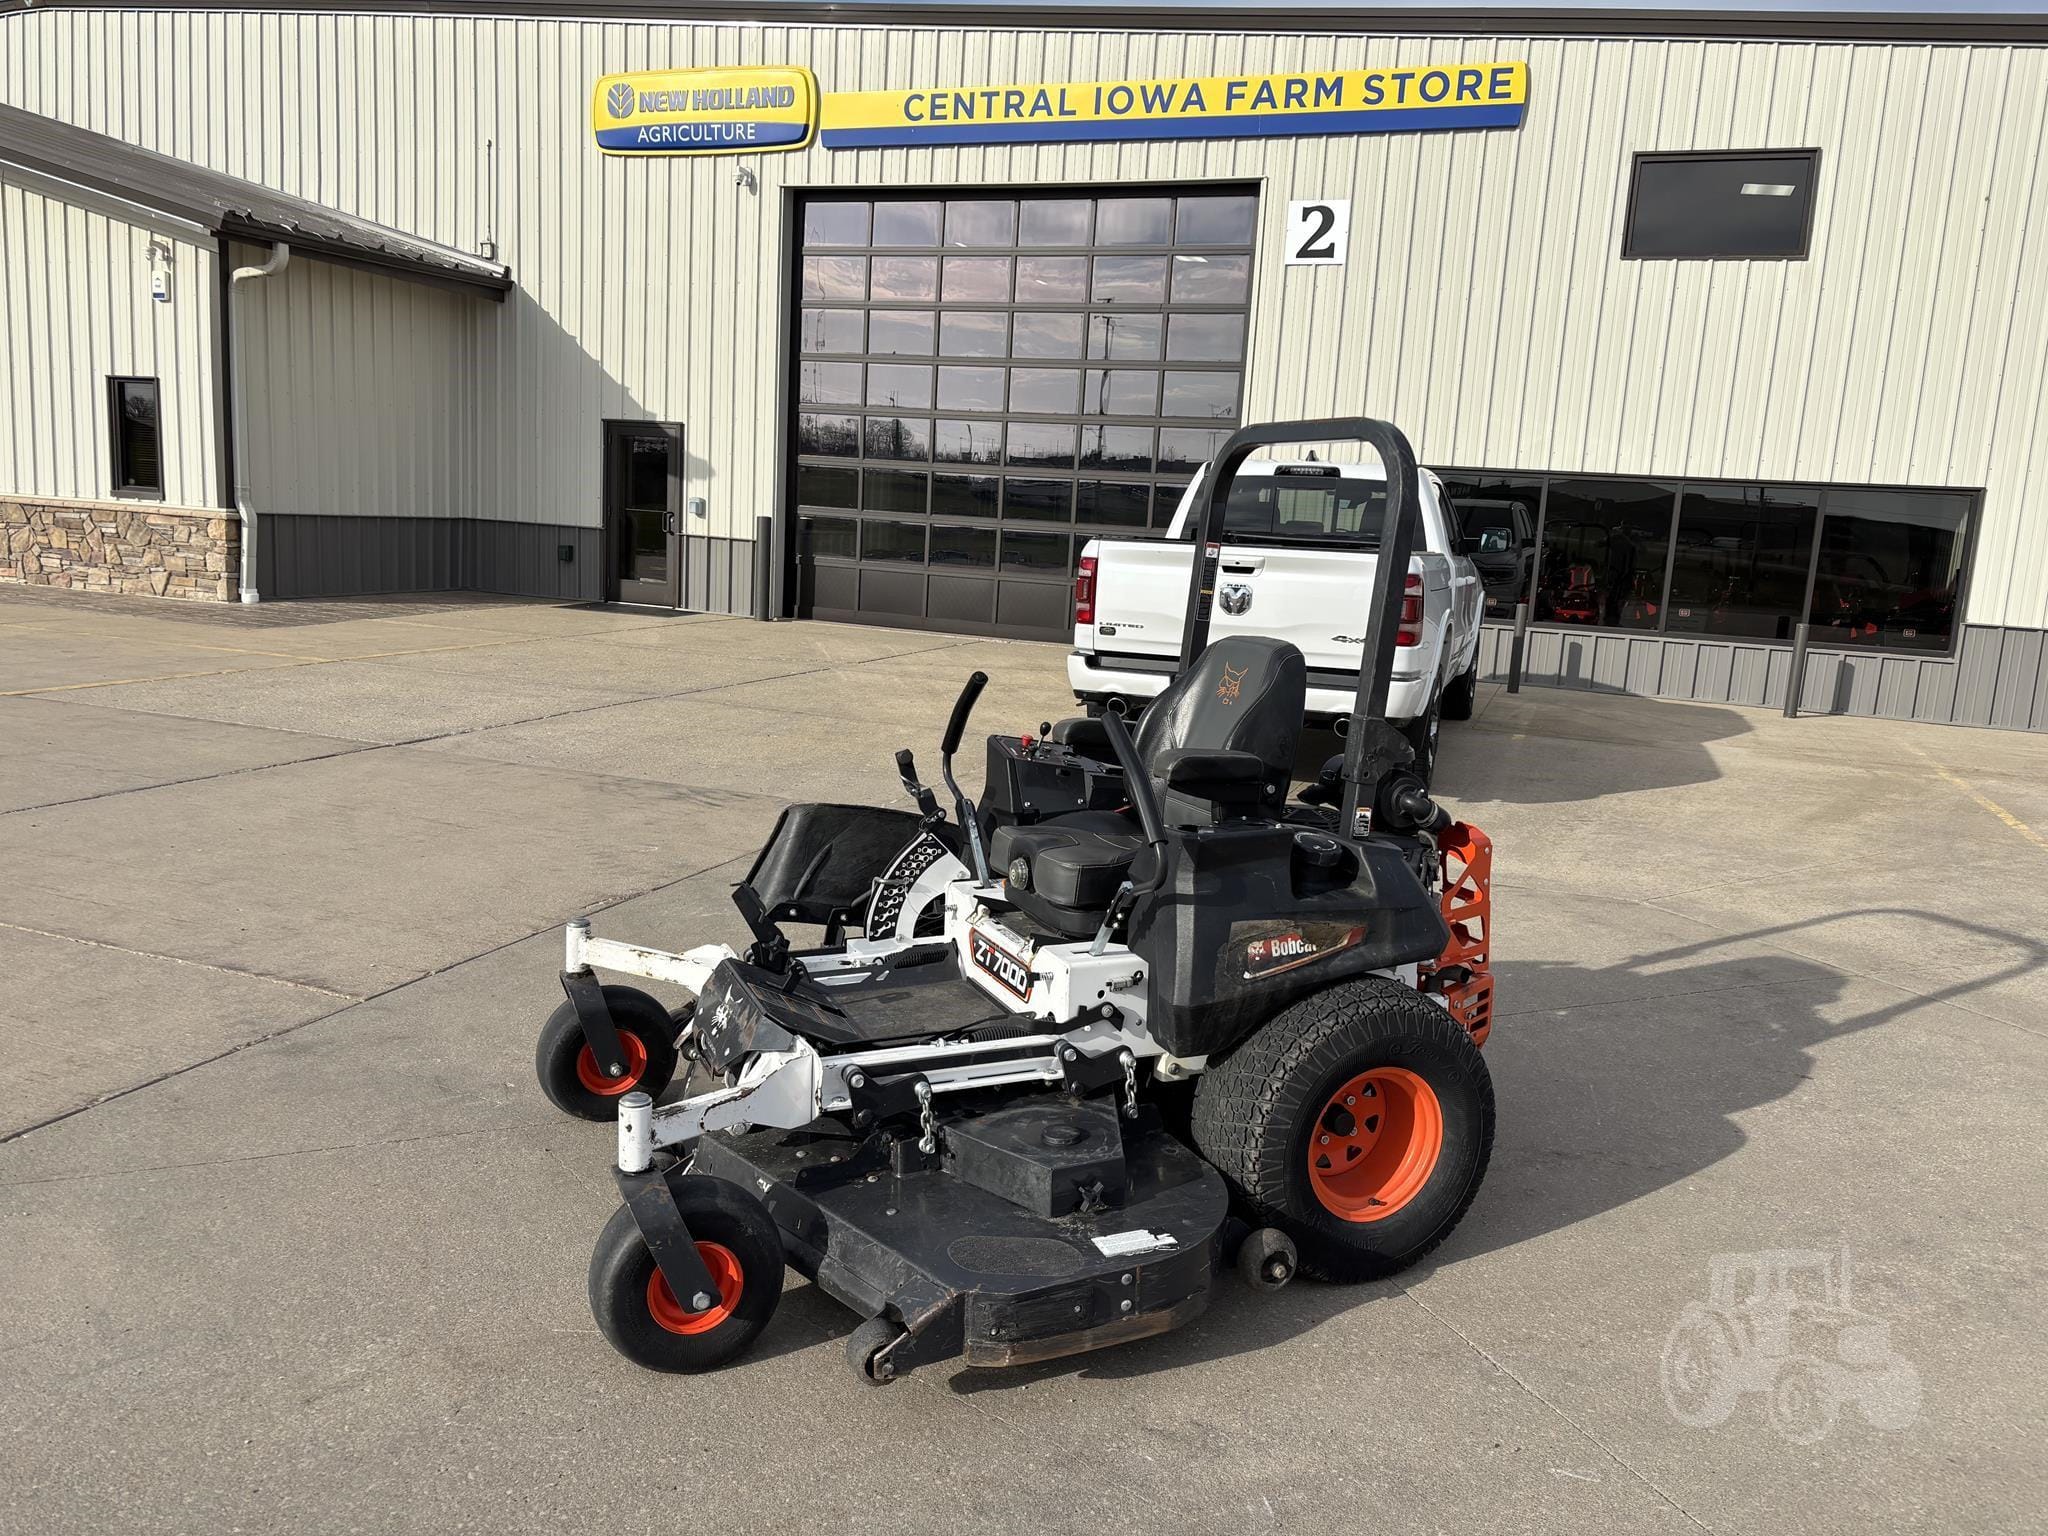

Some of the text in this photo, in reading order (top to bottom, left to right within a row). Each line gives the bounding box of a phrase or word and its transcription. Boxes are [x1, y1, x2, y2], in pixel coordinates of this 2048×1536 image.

[639, 86, 795, 112] NEW HOLLAND
[903, 67, 1515, 122] CENTRAL IOWA FARM STORE
[637, 123, 756, 143] AGRICULTURE
[1296, 205, 1335, 258] 2
